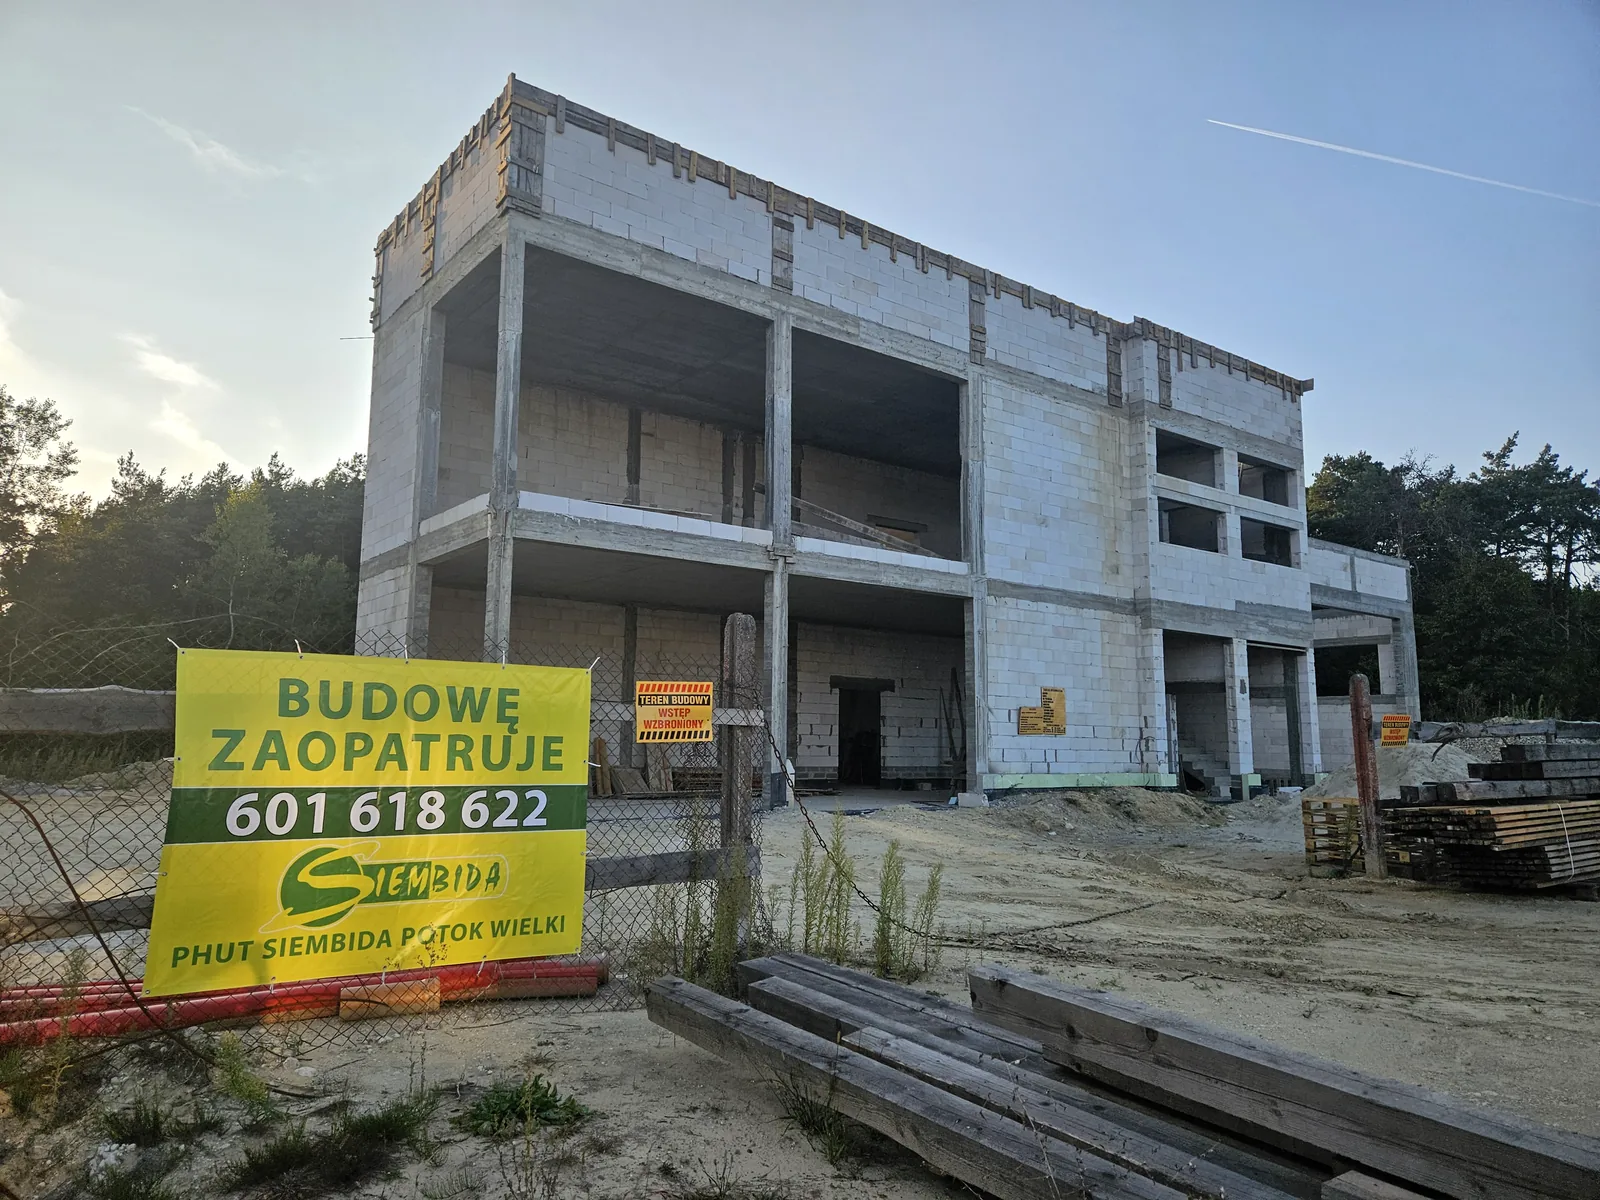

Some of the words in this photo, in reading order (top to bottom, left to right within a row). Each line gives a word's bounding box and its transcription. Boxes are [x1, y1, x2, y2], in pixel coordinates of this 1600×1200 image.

[278, 678, 521, 735] BUDOWĘ
[640, 695, 669, 704] TEREN
[671, 695, 709, 704] BUDOWY
[658, 708, 691, 719] WSTĘP
[643, 720, 704, 729] WZBRONIONY
[208, 729, 564, 771] ZAOPATRUJE
[225, 792, 327, 837] 601
[349, 791, 445, 832] 618
[461, 789, 548, 829] 622
[262, 842, 501, 932] SIEMBIDA
[171, 940, 254, 968] PHUT
[262, 929, 392, 960] SIEMBIDA
[401, 922, 483, 946] POTOK
[490, 915, 565, 936] WIELKI
